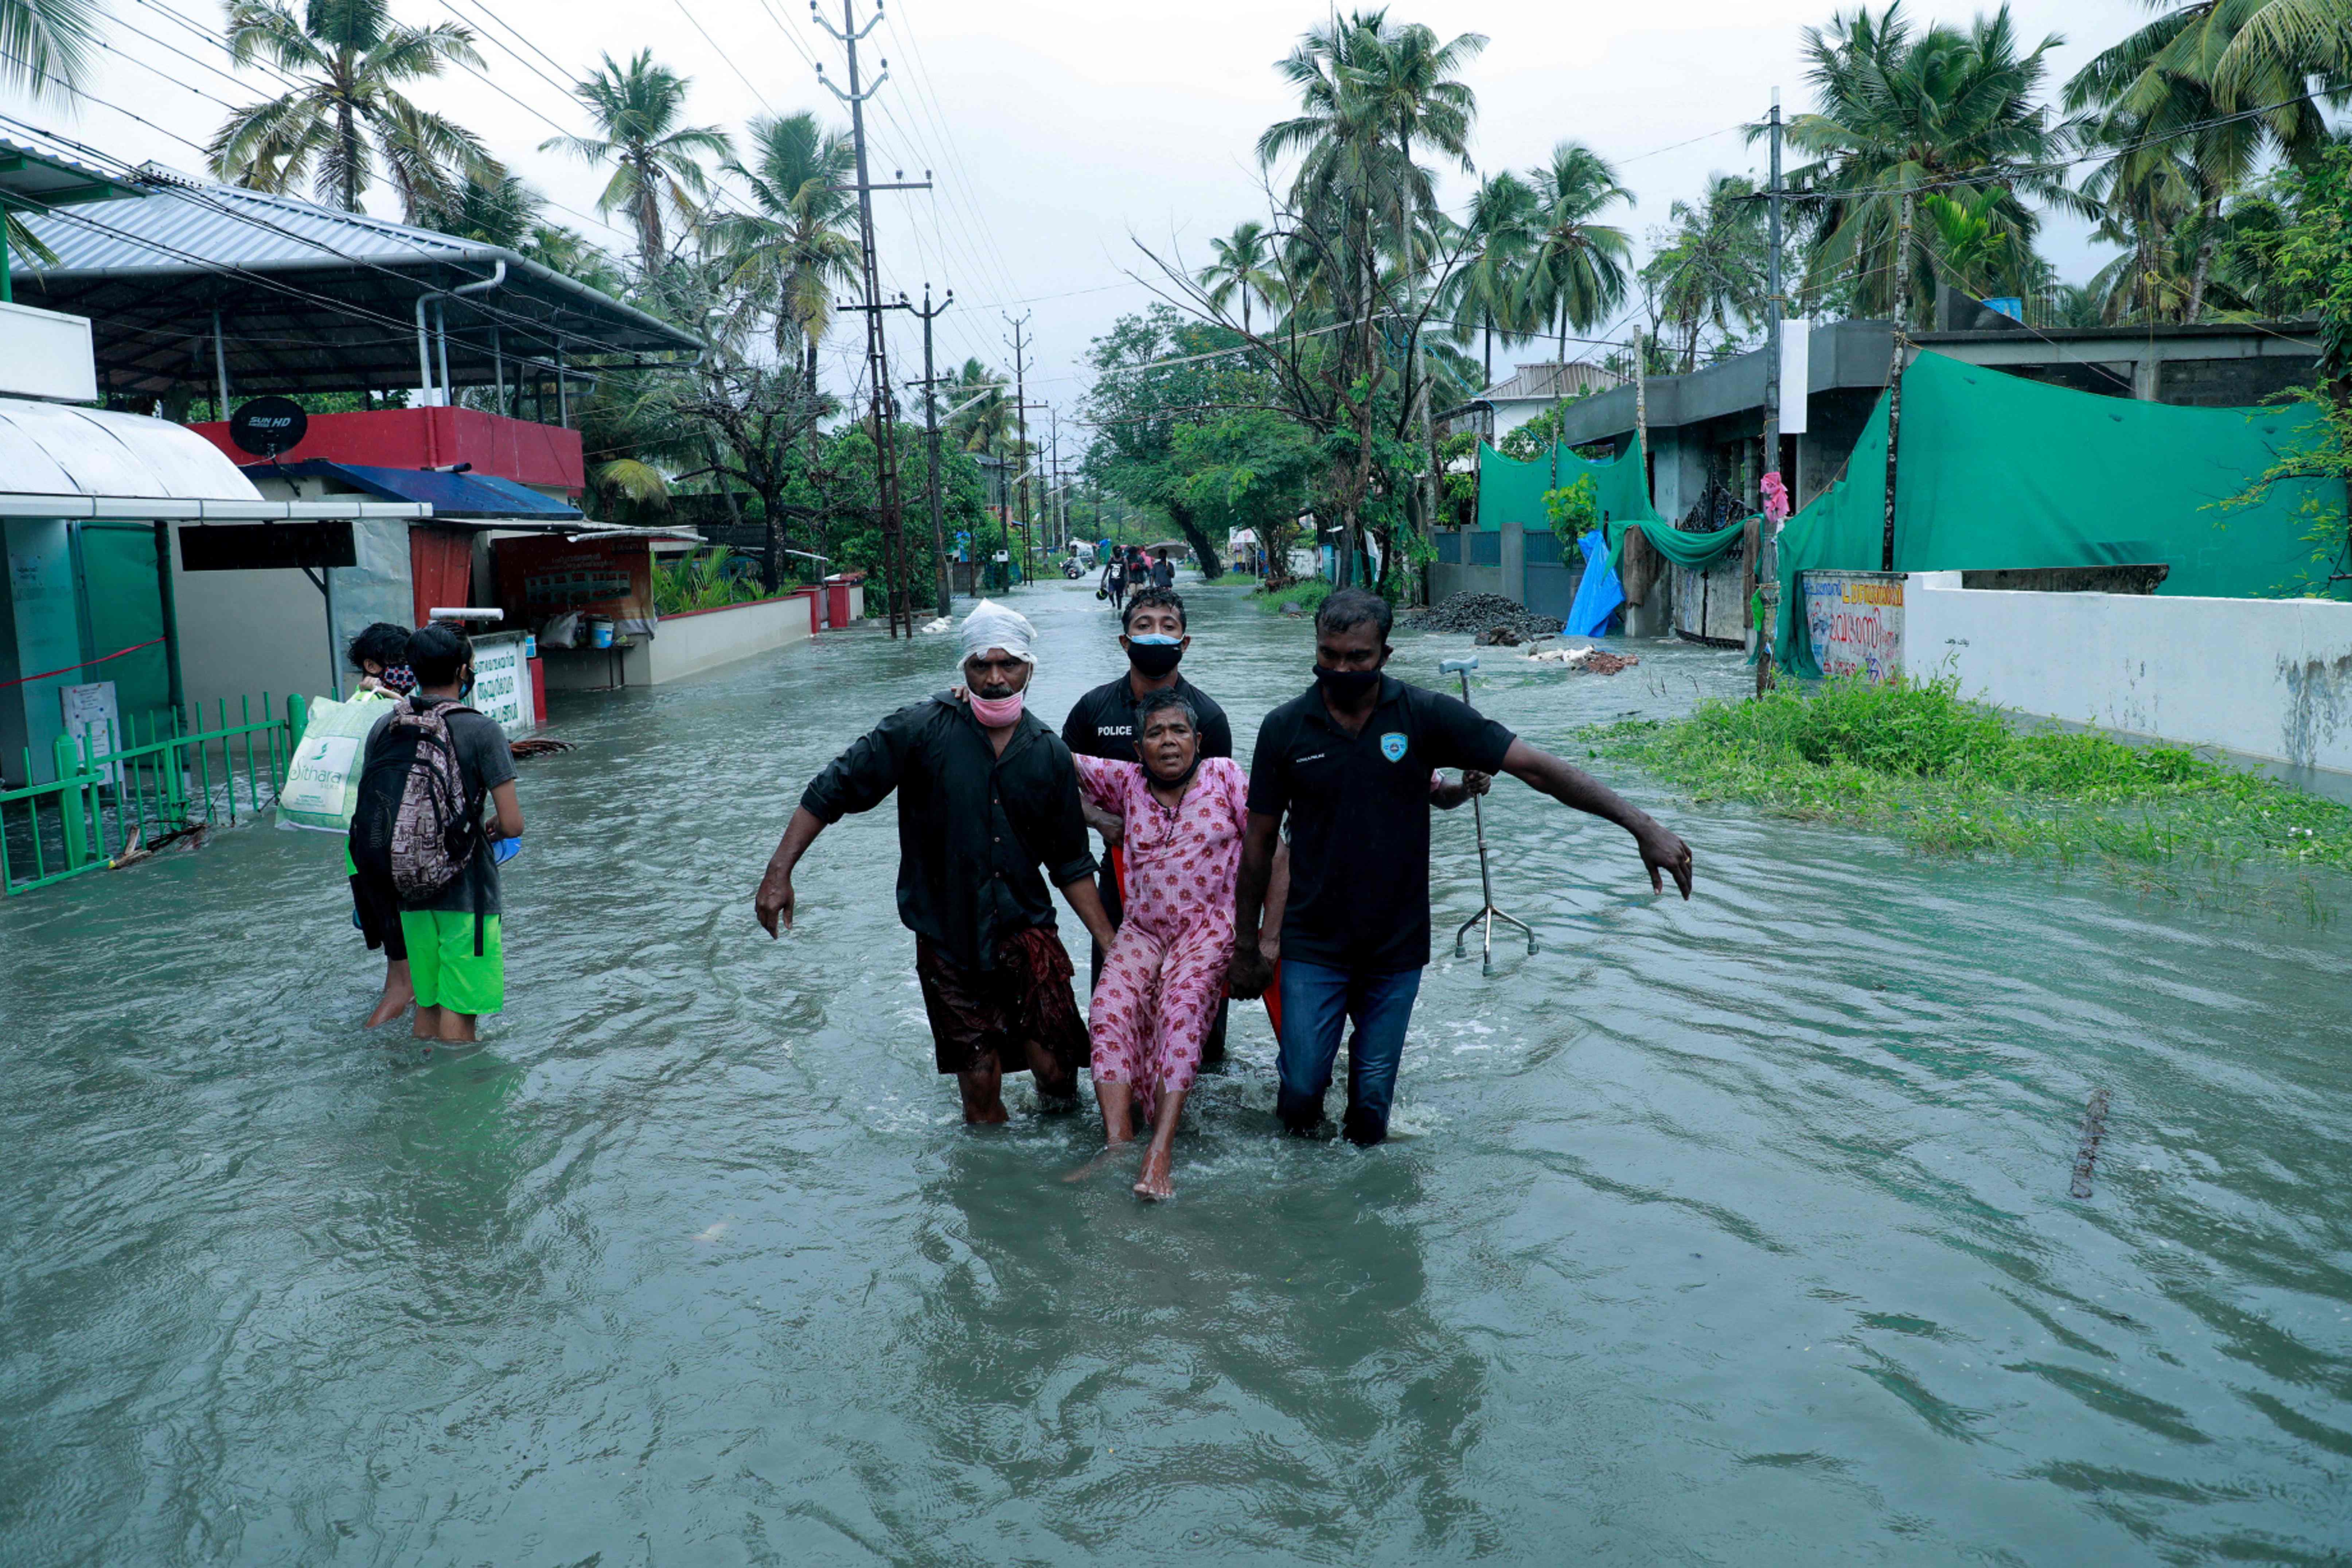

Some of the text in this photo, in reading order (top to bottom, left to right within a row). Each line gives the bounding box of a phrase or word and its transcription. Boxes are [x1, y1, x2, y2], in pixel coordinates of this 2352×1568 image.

[272, 417, 291, 427] HD
[1842, 583, 1864, 605] LDF
[1098, 726, 1132, 737] POLICE
[289, 756, 342, 784] Sithara
